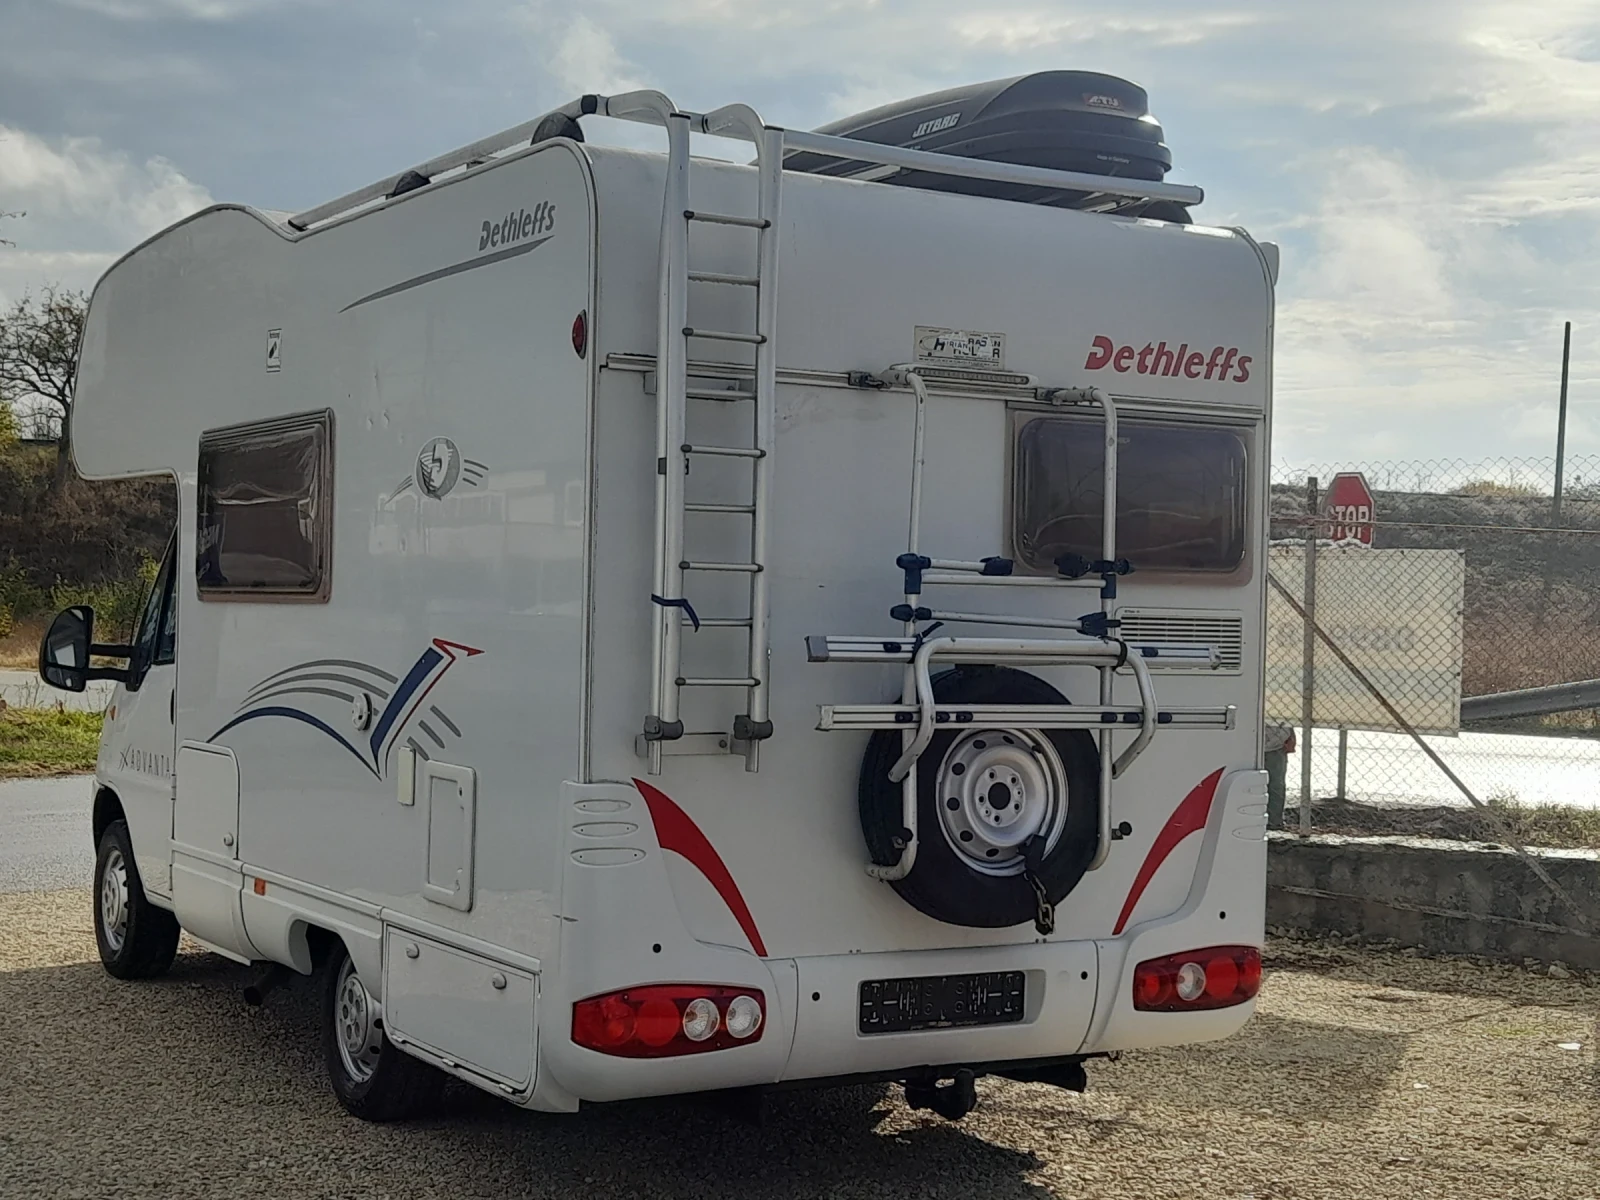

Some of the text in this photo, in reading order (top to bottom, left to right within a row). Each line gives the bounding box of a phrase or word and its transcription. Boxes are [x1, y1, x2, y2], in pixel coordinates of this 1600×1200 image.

[478, 200, 556, 251] Dethleffs
[1084, 335, 1252, 383] Dethleffs
[1325, 504, 1370, 539] STOP
